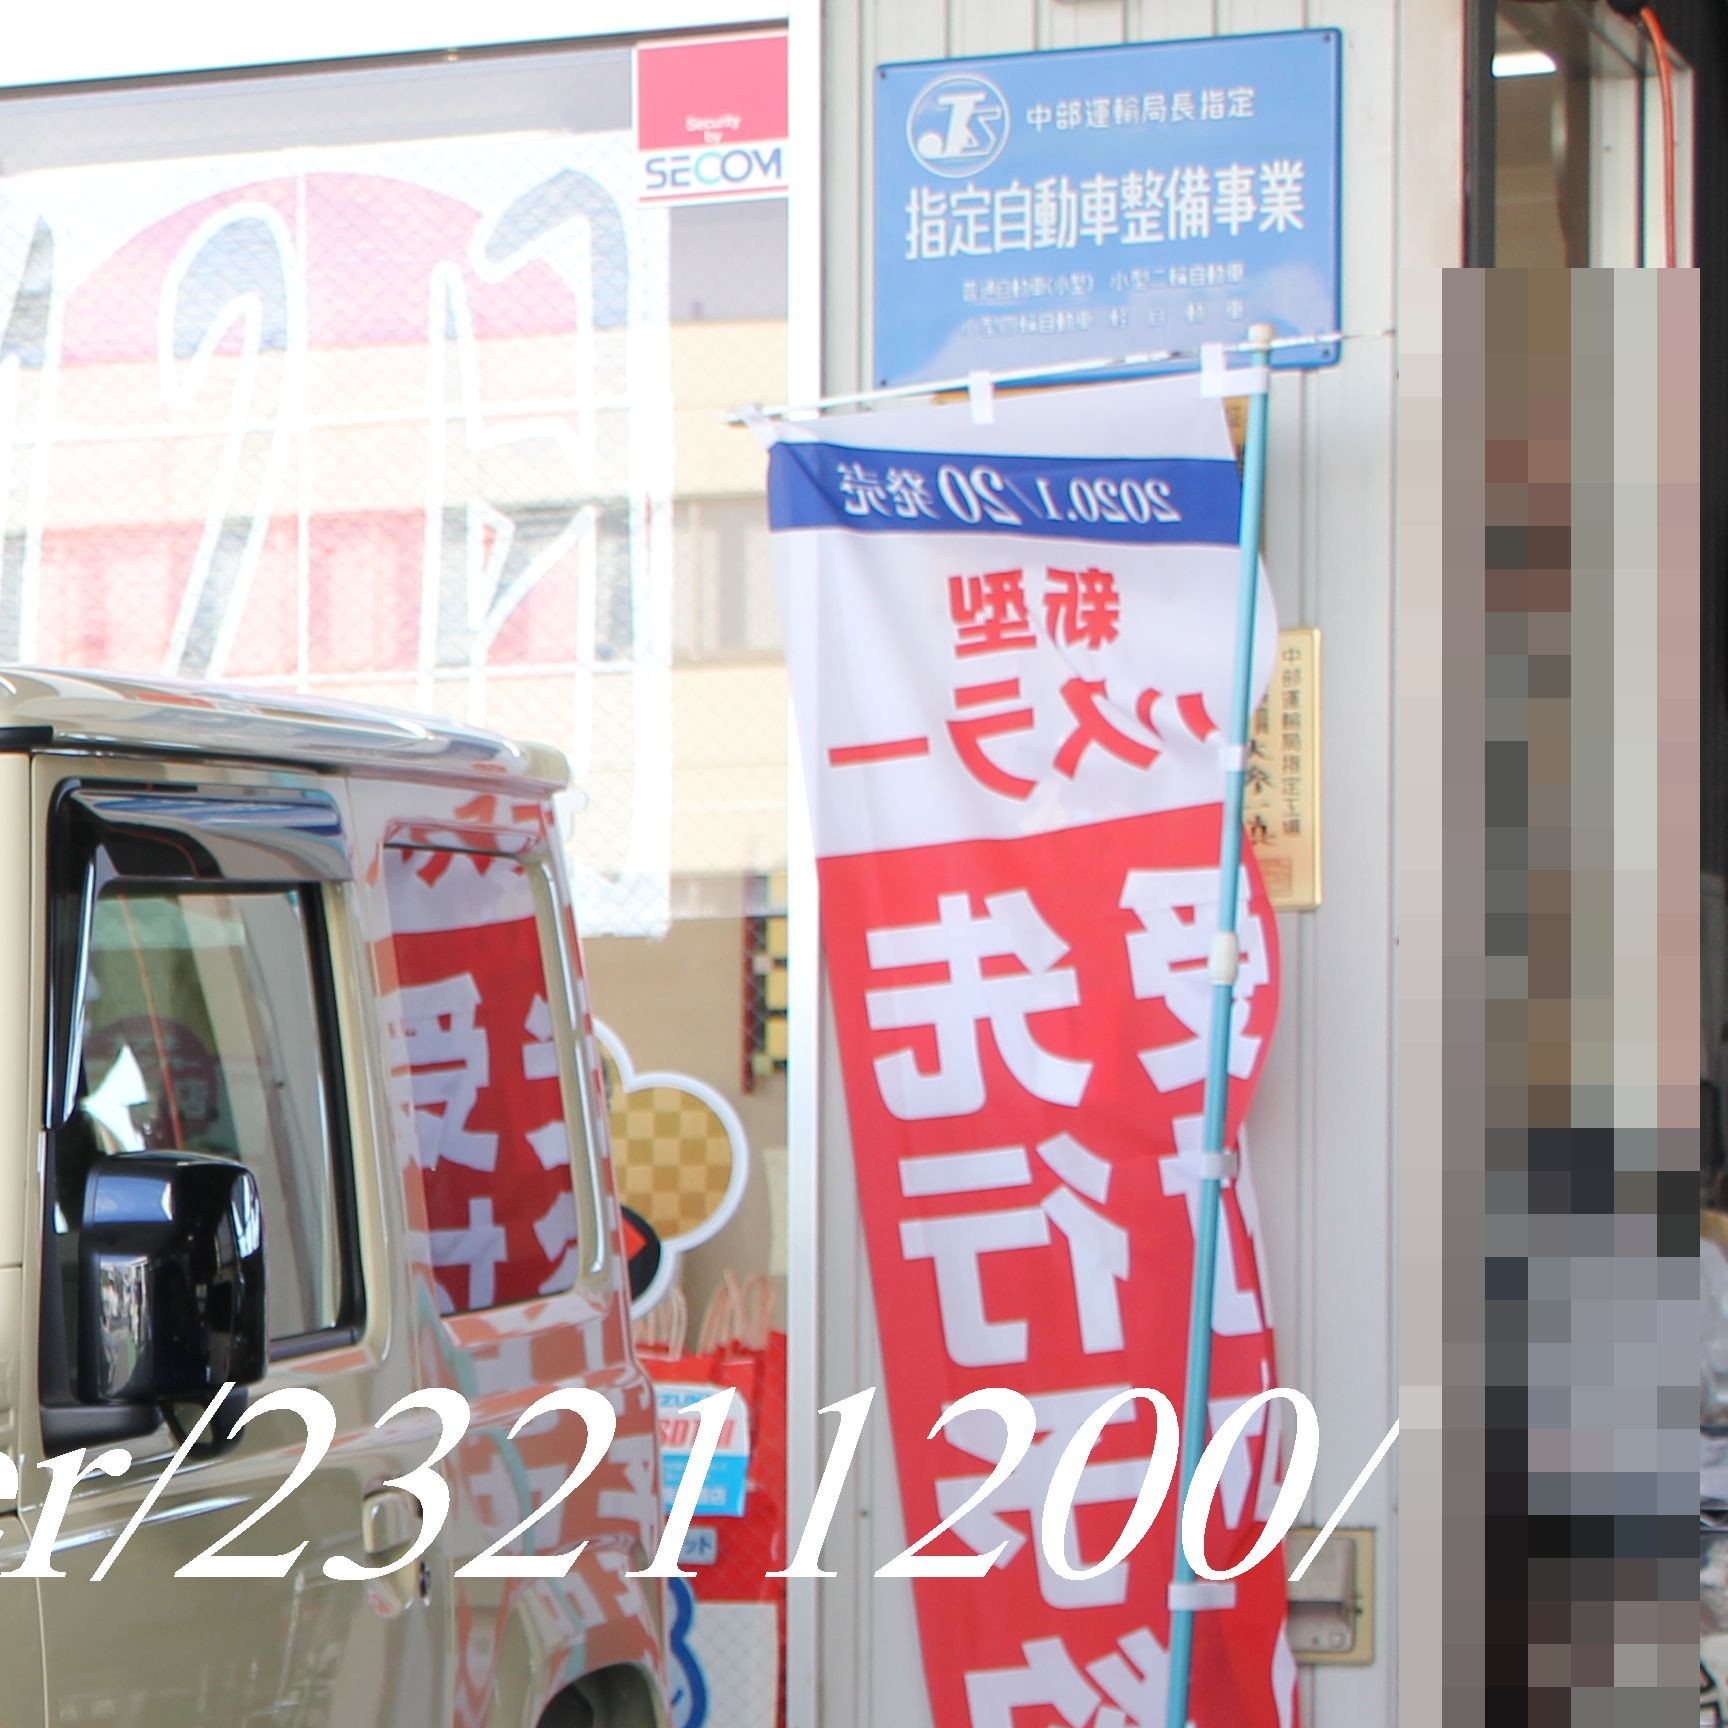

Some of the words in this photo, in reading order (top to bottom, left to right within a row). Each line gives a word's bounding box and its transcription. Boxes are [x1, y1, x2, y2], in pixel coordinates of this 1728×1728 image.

[685, 113, 742, 132] Security
[1025, 85, 1256, 133] 中部運輸局長指定
[645, 147, 782, 190] SECOM
[904, 160, 1306, 262] 指定自動車整備事業
